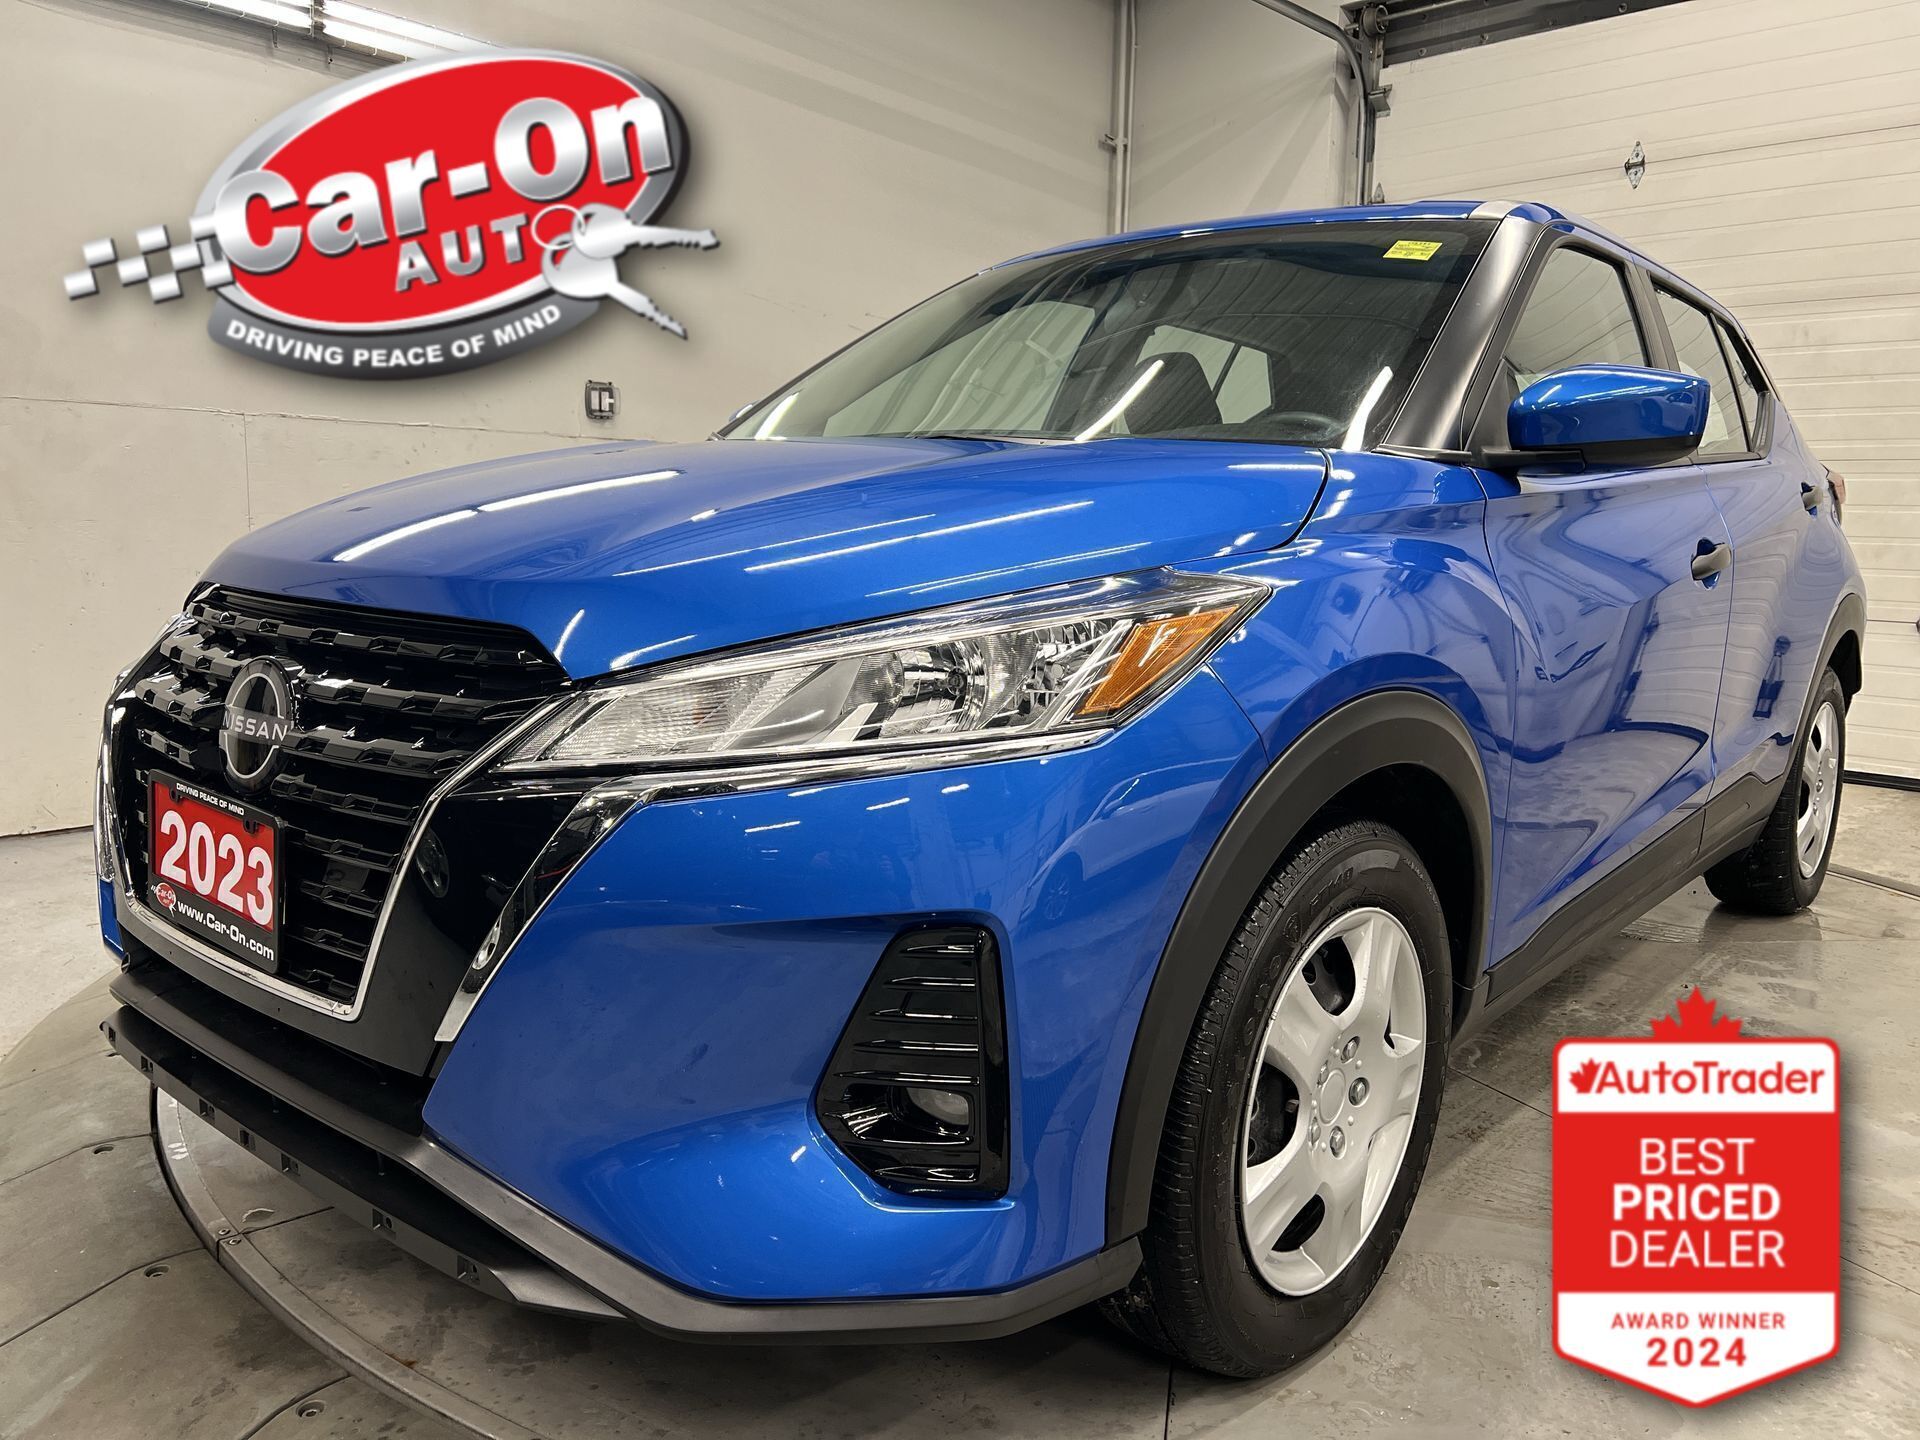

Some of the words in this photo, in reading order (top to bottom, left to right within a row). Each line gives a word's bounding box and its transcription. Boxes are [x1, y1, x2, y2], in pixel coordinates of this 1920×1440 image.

[223, 712, 288, 742] NISSAN
[176, 782, 199, 798] DRIVING
[199, 791, 219, 806] PEACE
[219, 799, 228, 809] OF
[228, 802, 245, 816] MIND
[160, 810, 273, 926] 2023
[177, 900, 275, 961] www.Car-On.com
